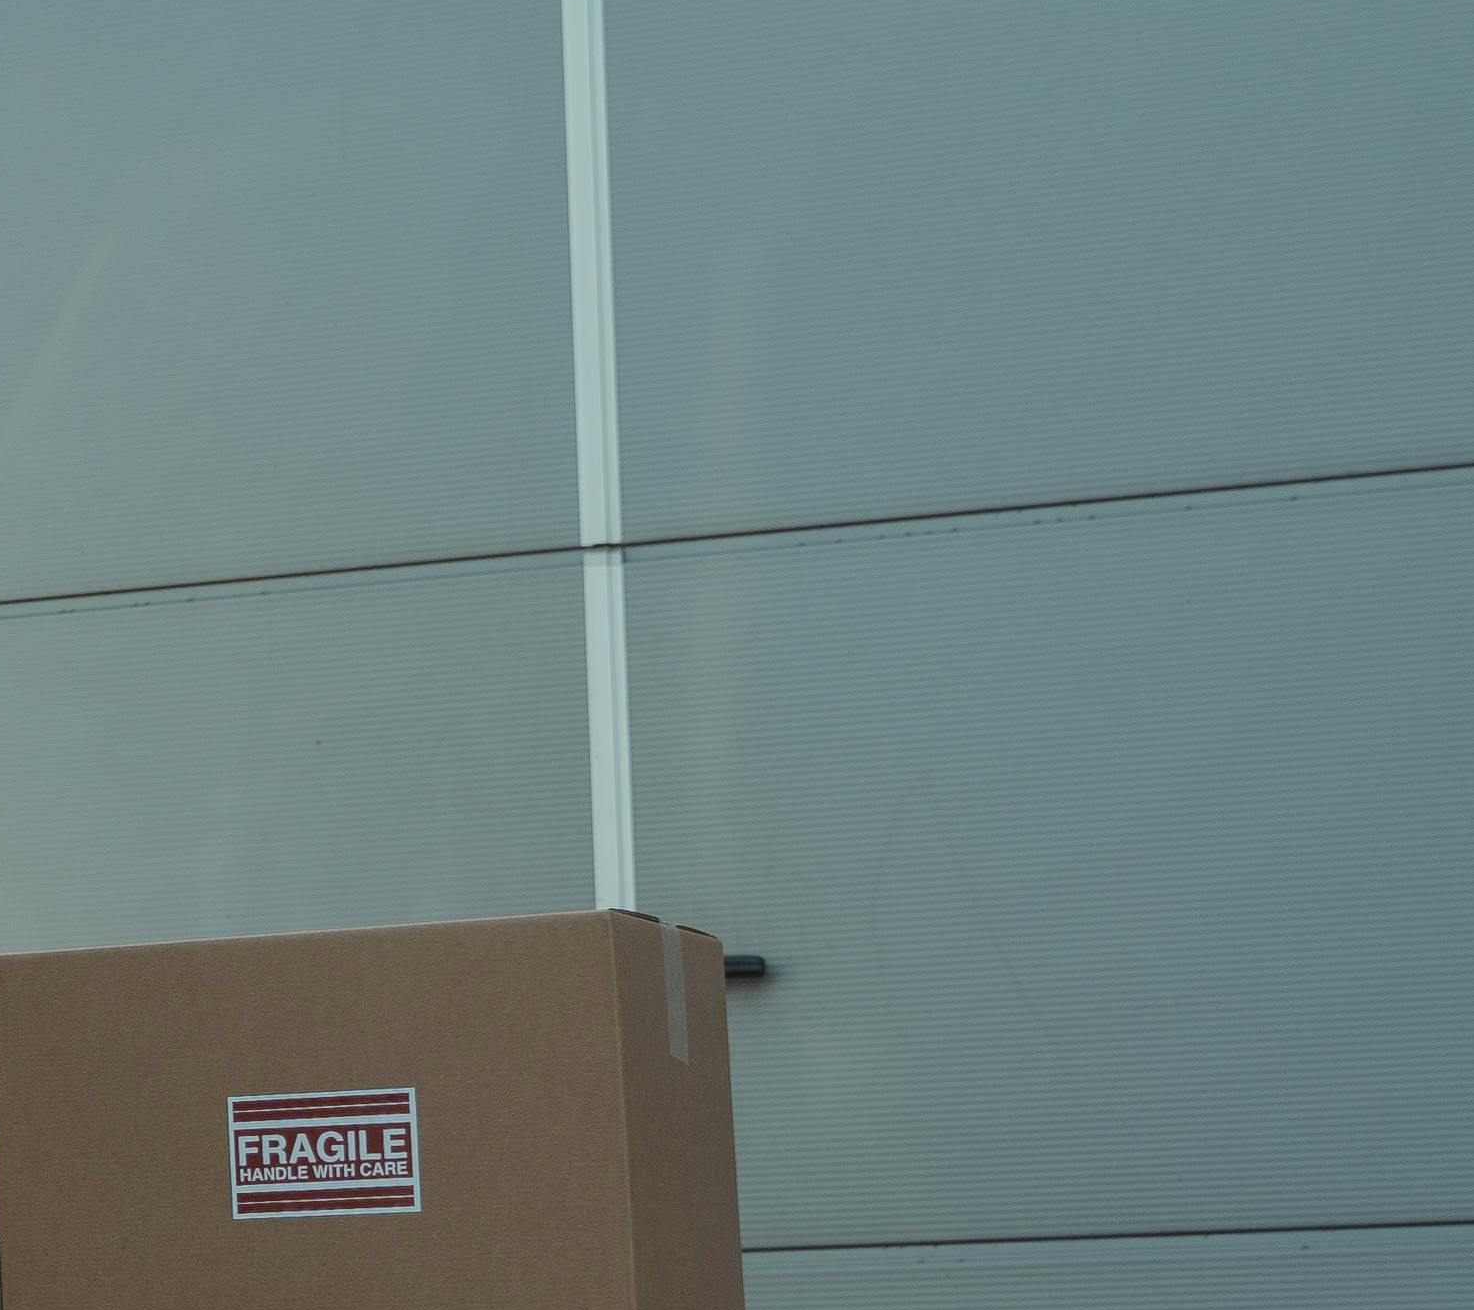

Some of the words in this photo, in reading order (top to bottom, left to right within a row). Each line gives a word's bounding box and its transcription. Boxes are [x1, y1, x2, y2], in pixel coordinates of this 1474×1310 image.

[237, 1128, 408, 1167] FRAGILE
[239, 1166, 309, 1182] HANDLE
[312, 1163, 355, 1179] WITH
[359, 1160, 408, 1177] CARE
